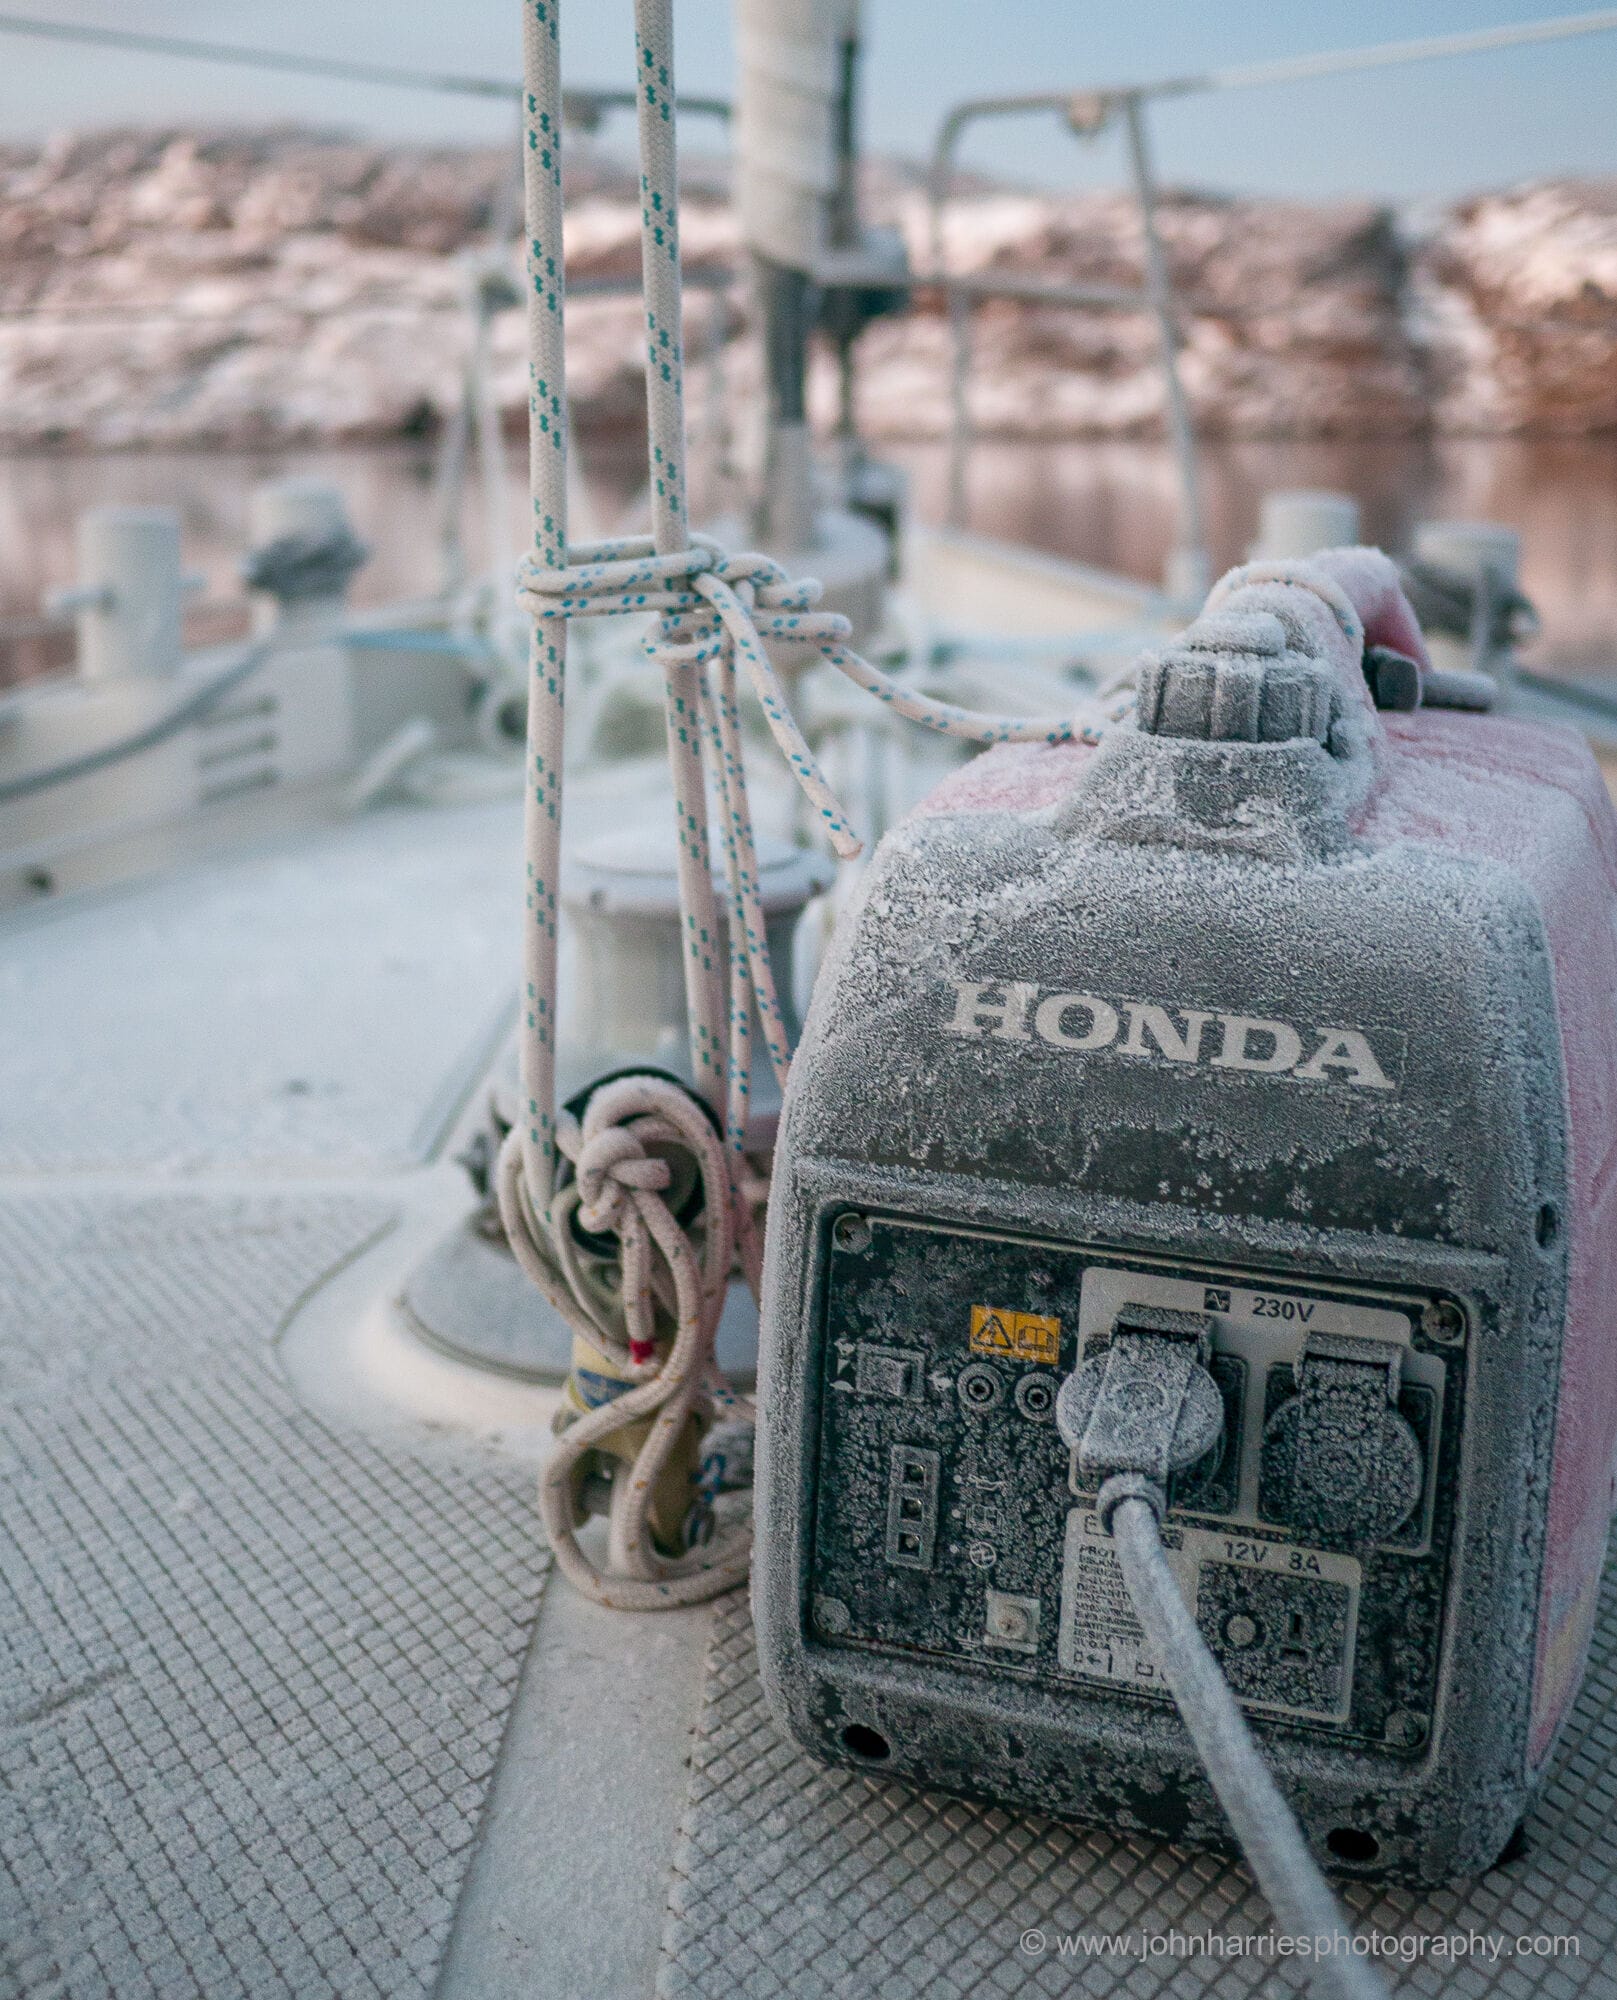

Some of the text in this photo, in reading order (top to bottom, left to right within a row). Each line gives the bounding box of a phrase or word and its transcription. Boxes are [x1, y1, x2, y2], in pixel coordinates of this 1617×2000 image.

[944, 981, 1395, 1089] HONDA
[1252, 1296, 1315, 1322] 230V
[1223, 1540, 1267, 1563] 12V
